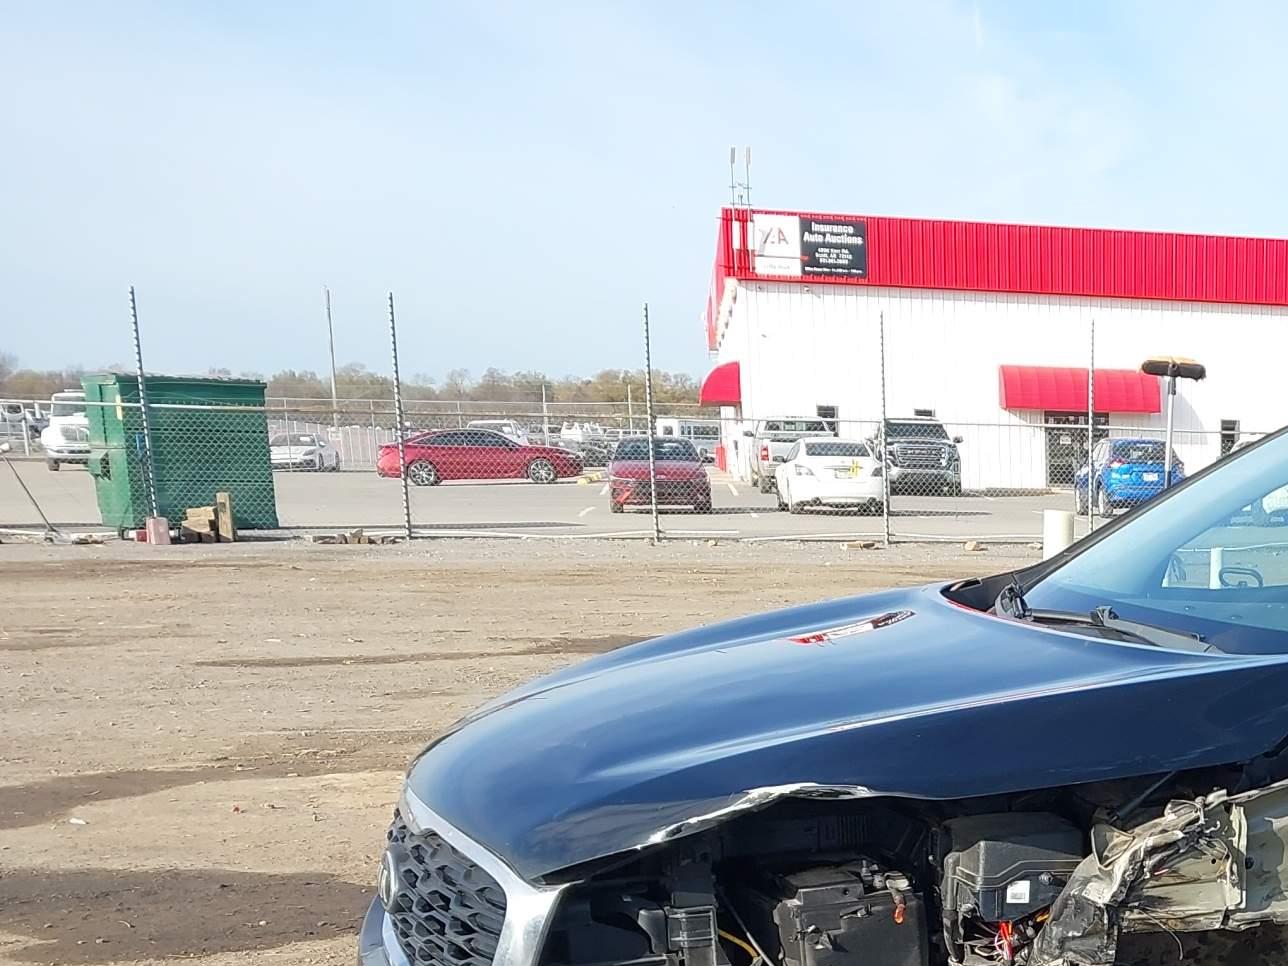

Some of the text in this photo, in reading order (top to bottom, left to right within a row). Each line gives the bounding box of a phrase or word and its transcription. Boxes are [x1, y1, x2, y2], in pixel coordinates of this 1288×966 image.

[811, 221, 854, 234] Insurance
[803, 231, 864, 245] Auto Auctions
